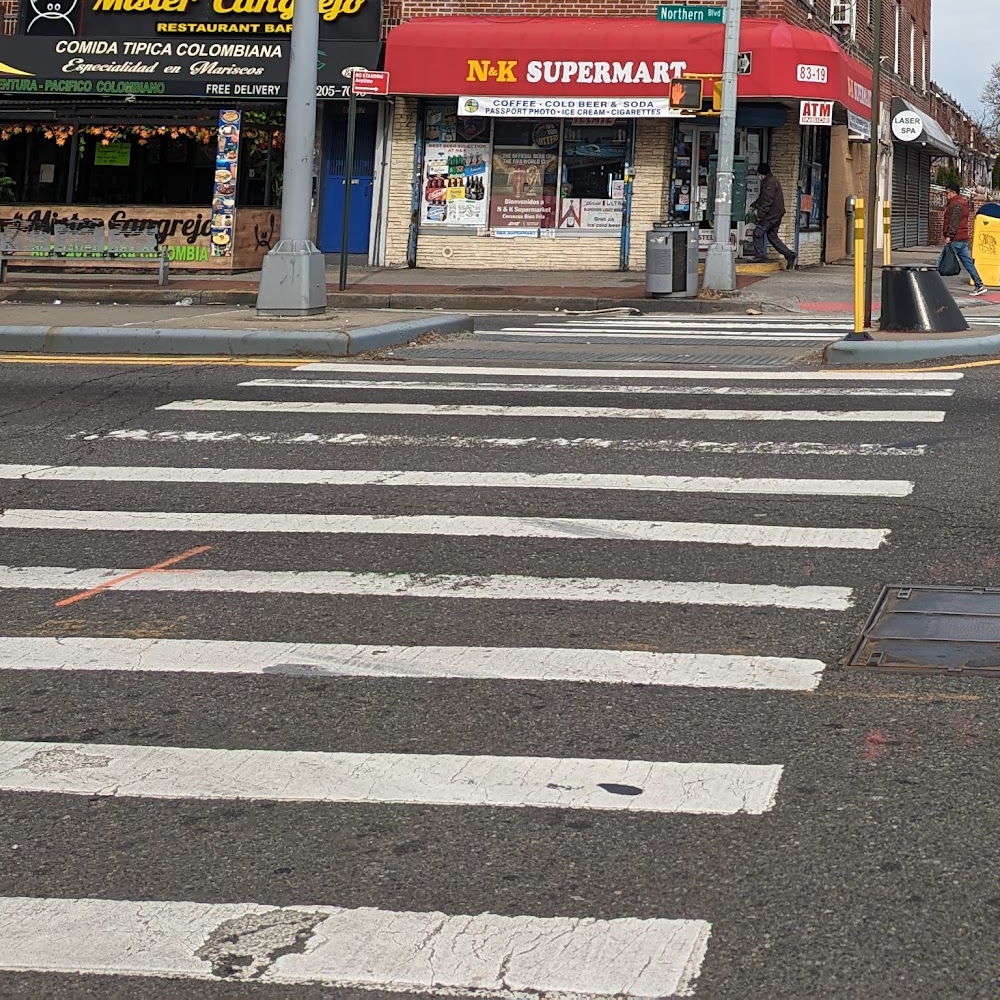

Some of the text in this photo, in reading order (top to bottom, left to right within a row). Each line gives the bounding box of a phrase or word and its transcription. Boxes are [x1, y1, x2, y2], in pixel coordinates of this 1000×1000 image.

[660, 6, 721, 21] Northern Blvd
[156, 22, 260, 34] RESTAURANT
[55, 40, 282, 58] COMIDA TIPICA COLOMBIANA
[61, 58, 265, 76] Especialidad en Mariscos
[465, 59, 687, 84] N&K SUPERMART
[799, 66, 826, 81] 83-19
[45, 80, 92, 93] PACIFICO
[96, 81, 166, 94] COLOMBIANO
[206, 83, 231, 95] FREE
[234, 84, 281, 96] DELIVERY
[492, 99, 537, 108] COFFEE
[544, 100, 575, 108] COLD
[578, 101, 608, 109] BEER
[623, 101, 655, 109] SODA
[802, 101, 831, 117] ATM
[485, 107, 529, 115] PASSPORT
[528, 107, 556, 116] PHOTO
[561, 108, 575, 116] ICE
[577, 108, 605, 116] CREAM
[611, 108, 662, 116] CIGARETTES
[894, 117, 920, 125] LASER
[900, 127, 917, 135] SPA
